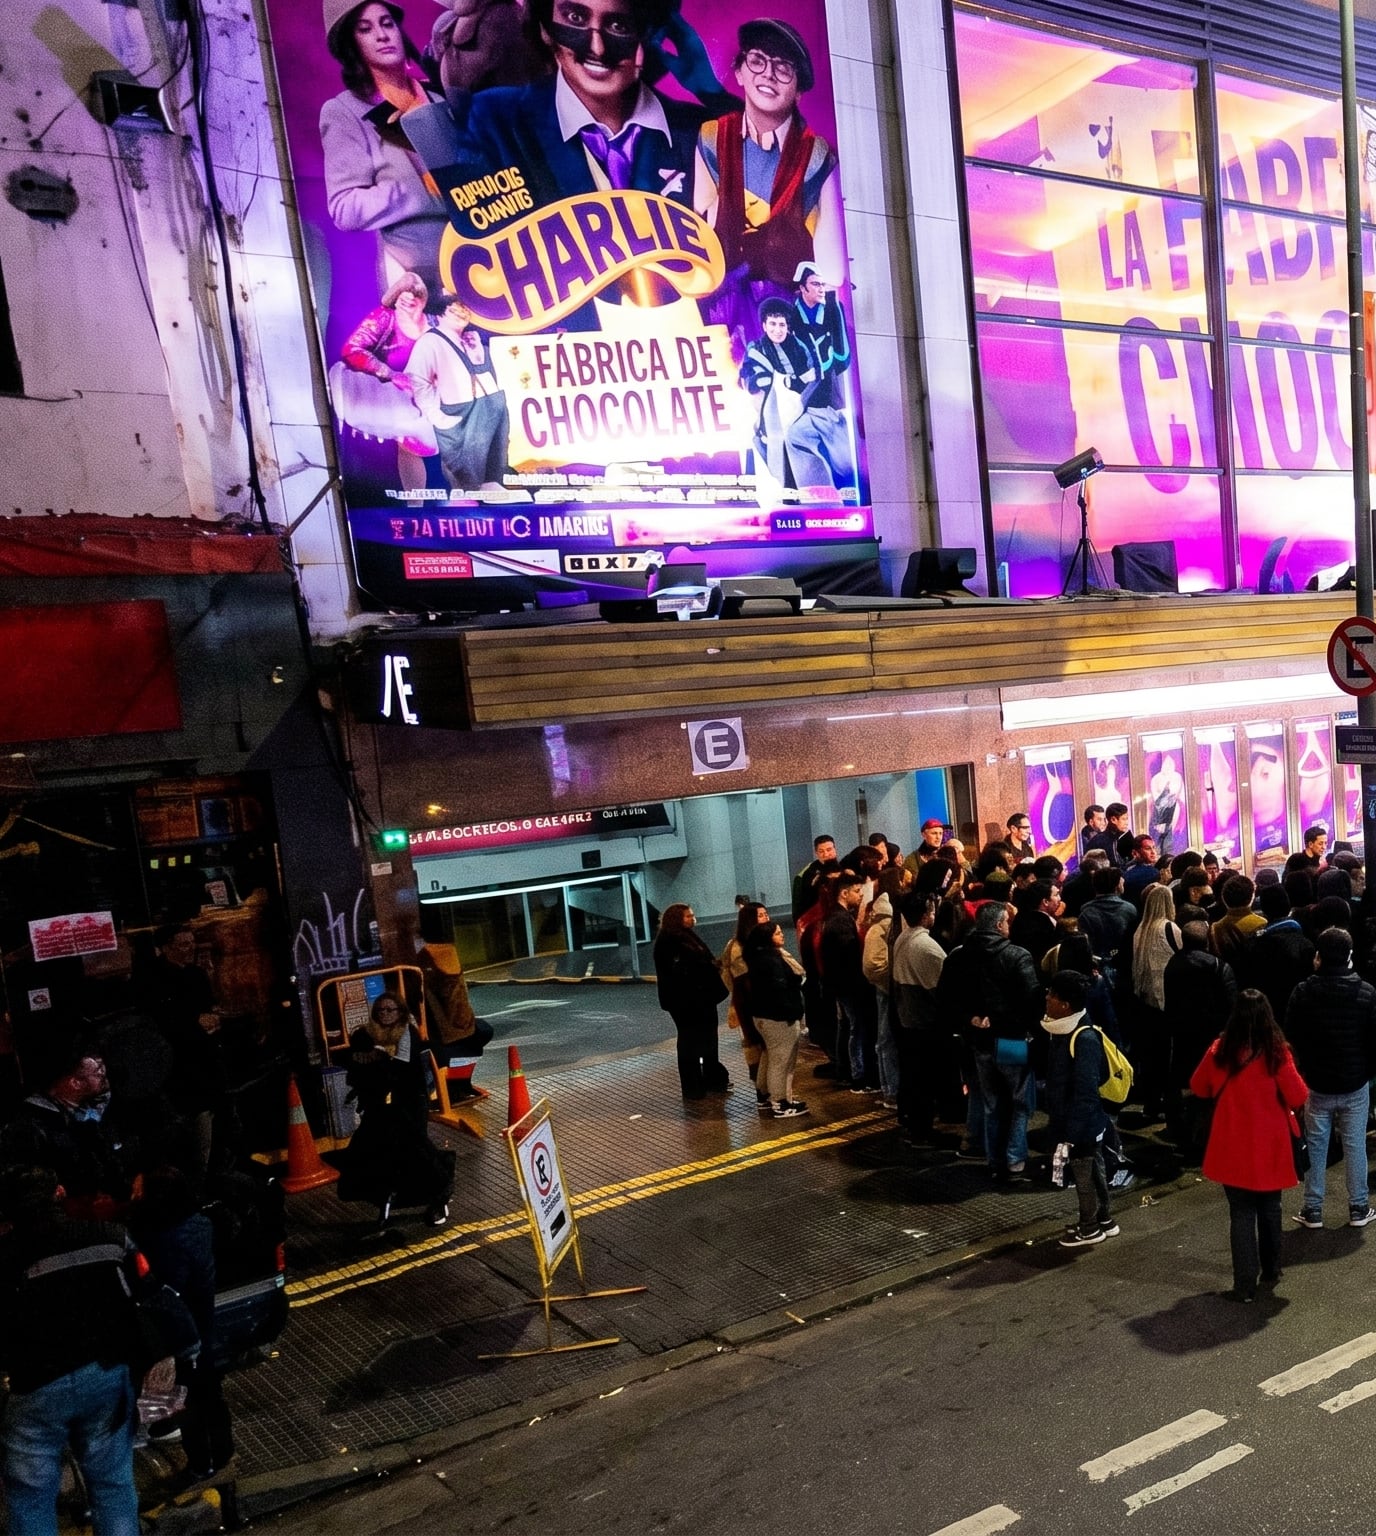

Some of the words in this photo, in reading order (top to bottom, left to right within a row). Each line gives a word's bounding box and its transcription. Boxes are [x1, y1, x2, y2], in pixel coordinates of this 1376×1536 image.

[450, 197, 711, 322] CHARLIE
[1097, 208, 1152, 291] LA
[534, 332, 669, 389] FÁBRICA
[675, 336, 718, 380] DE
[521, 384, 731, 449] CHOCOLATE
[703, 728, 731, 764] E
